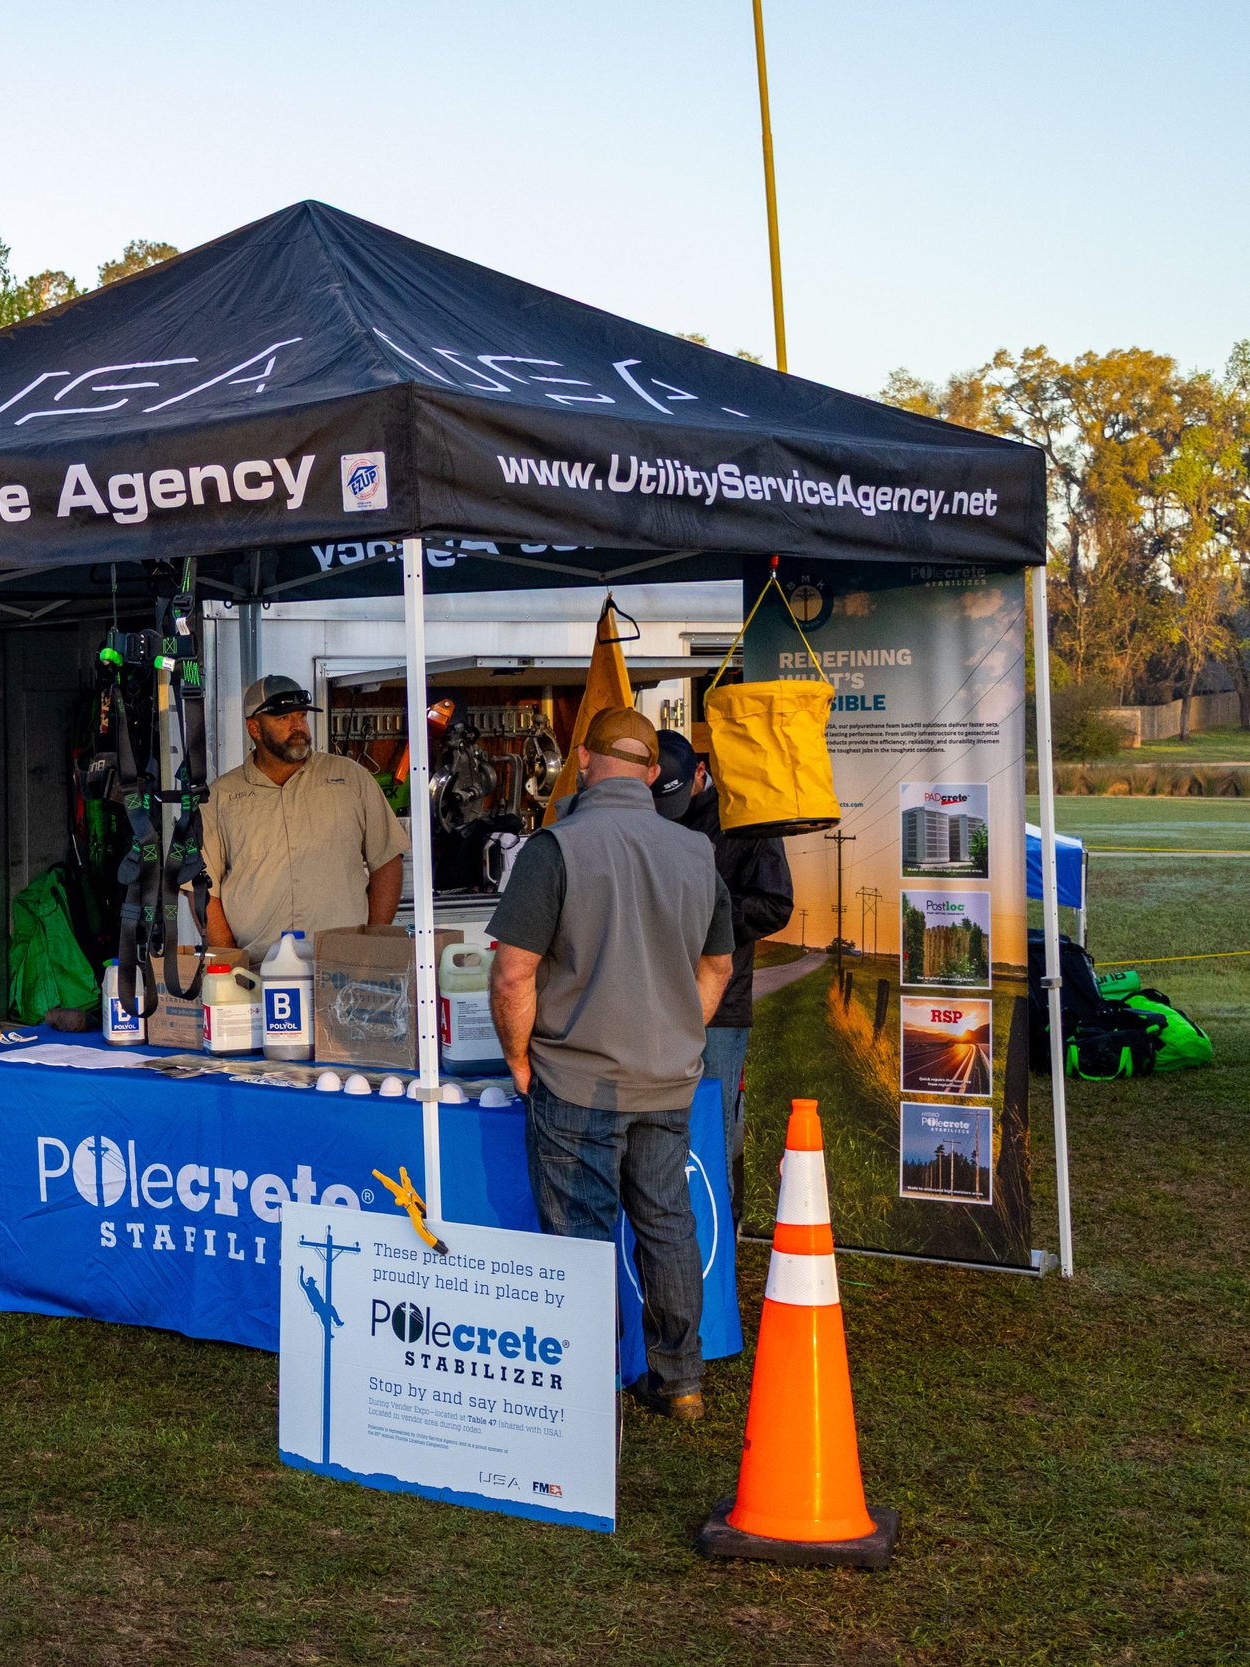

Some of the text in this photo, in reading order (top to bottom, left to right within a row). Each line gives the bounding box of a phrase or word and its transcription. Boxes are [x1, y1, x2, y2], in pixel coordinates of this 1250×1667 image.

[57, 454, 316, 525] Agency
[496, 454, 998, 521] www.UtilityServiceAgency.net
[779, 649, 912, 669] REDEFINING
[831, 694, 886, 711] SIBLE
[926, 900, 964, 911] Postloc
[274, 993, 291, 1019] B
[930, 1009, 963, 1024] RSP
[270, 1022, 297, 1030] POLYOL
[373, 1243, 565, 1281] These practice poles are
[373, 1268, 565, 1308] proudly held in place by
[405, 1351, 562, 1390] STABILIZER
[369, 1376, 565, 1423] Stop by and say howdy!
[368, 1397, 390, 1410] During
[467, 1415, 487, 1425] Table
[488, 1419, 497, 1427] 47
[525, 1425, 542, 1434] with
[368, 1407, 392, 1418] Located
[393, 1412, 400, 1420] in
[401, 1413, 423, 1424] vendor
[424, 1419, 439, 1427] area
[439, 1421, 461, 1432] during
[479, 1471, 520, 1490] USA
